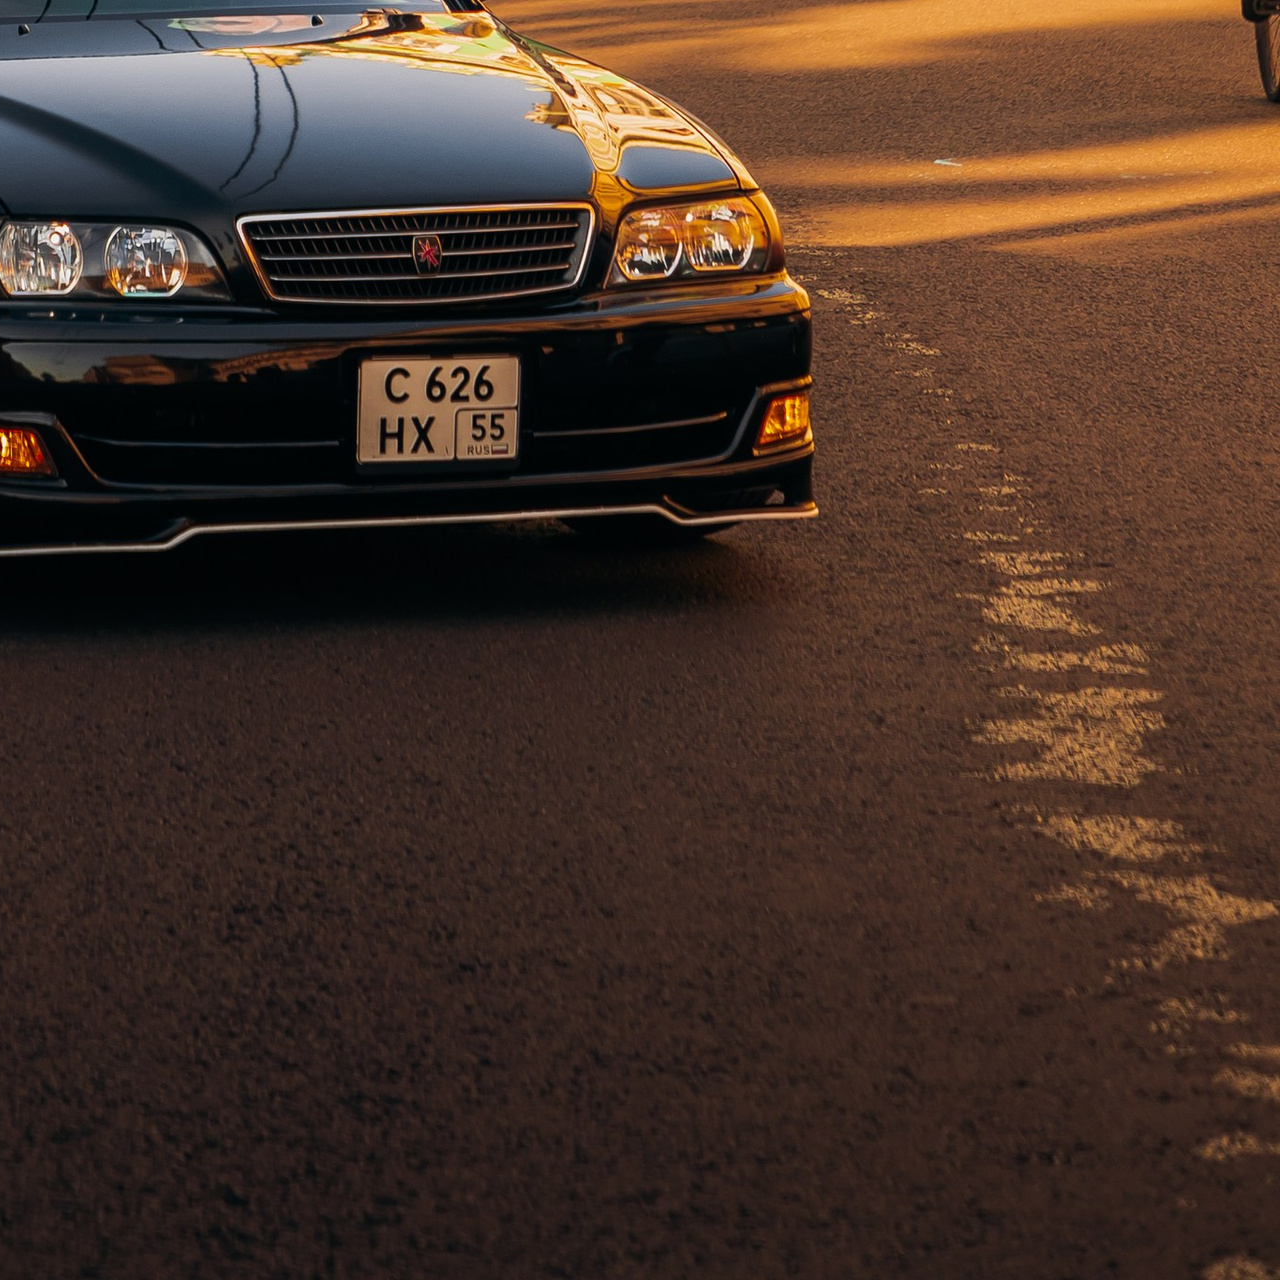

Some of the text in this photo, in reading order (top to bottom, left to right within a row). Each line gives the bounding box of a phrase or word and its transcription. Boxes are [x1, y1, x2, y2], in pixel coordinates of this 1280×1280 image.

[425, 365, 494, 404] 626
[471, 413, 506, 442] 55
[466, 444, 490, 456] RUS
